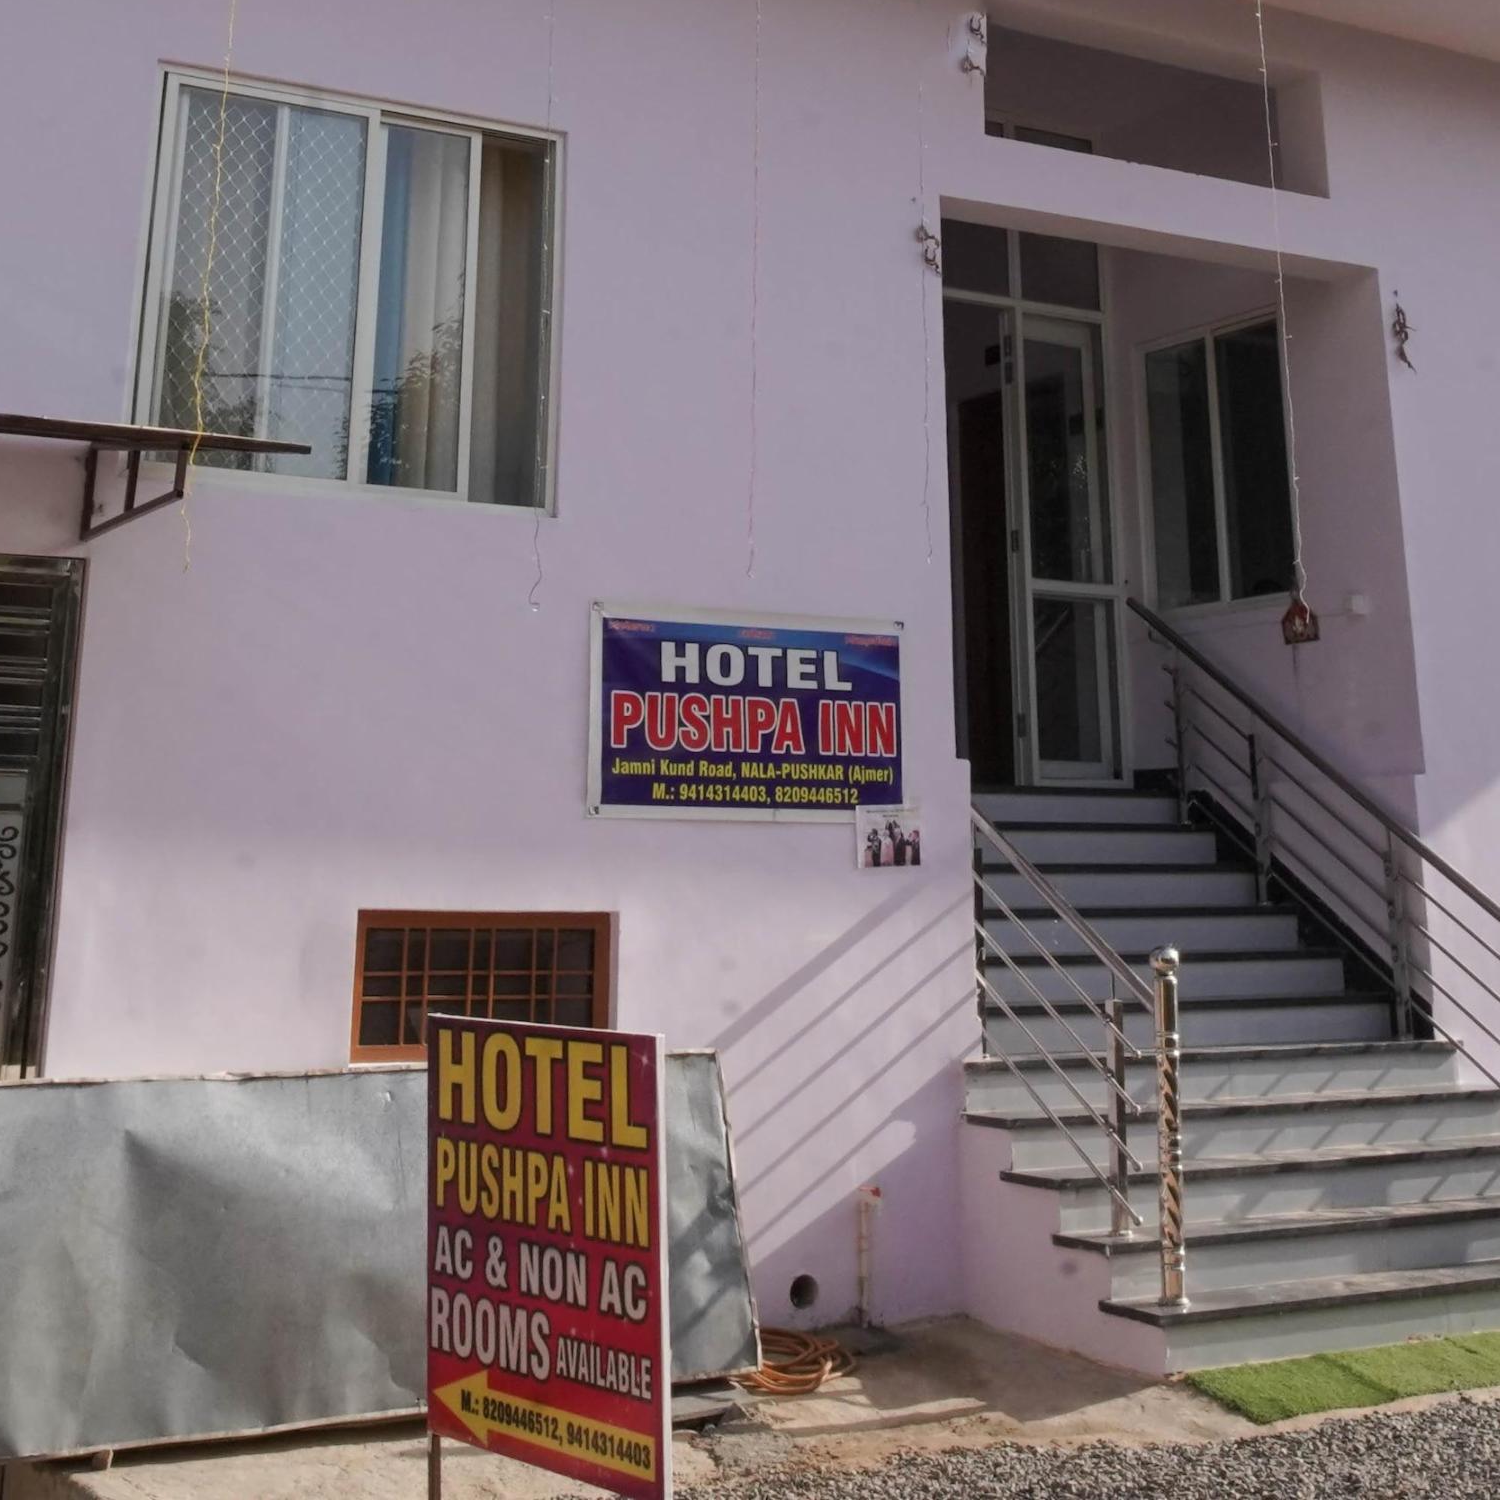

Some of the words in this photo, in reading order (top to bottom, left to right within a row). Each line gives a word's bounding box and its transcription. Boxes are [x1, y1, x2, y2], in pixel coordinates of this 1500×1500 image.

[661, 641, 852, 691] HOTEL
[611, 690, 805, 754] PUSHPA
[819, 701, 897, 757] INN
[611, 758, 655, 776] Jamni
[660, 759, 694, 776] Kund
[700, 760, 737, 779] Road,
[741, 762, 844, 781] NALA-PUSHKAR
[848, 766, 893, 784] (Ajmer)
[652, 783, 675, 800] M.:
[679, 784, 771, 804] 9414314403,
[775, 787, 859, 804] 8209446512
[439, 1029, 648, 1149] HOTEL
[436, 1137, 572, 1233] PUSHPA
[584, 1160, 649, 1248] INN
[435, 1225, 473, 1280] AC
[485, 1236, 508, 1289] &
[519, 1243, 588, 1307] NON
[600, 1261, 647, 1321] AC
[431, 1287, 550, 1381] ROOMS
[556, 1336, 652, 1400] AVAILABLE
[461, 1389, 479, 1415] M.:
[483, 1397, 563, 1446] 8209446512,
[567, 1420, 651, 1470] 9414314403
